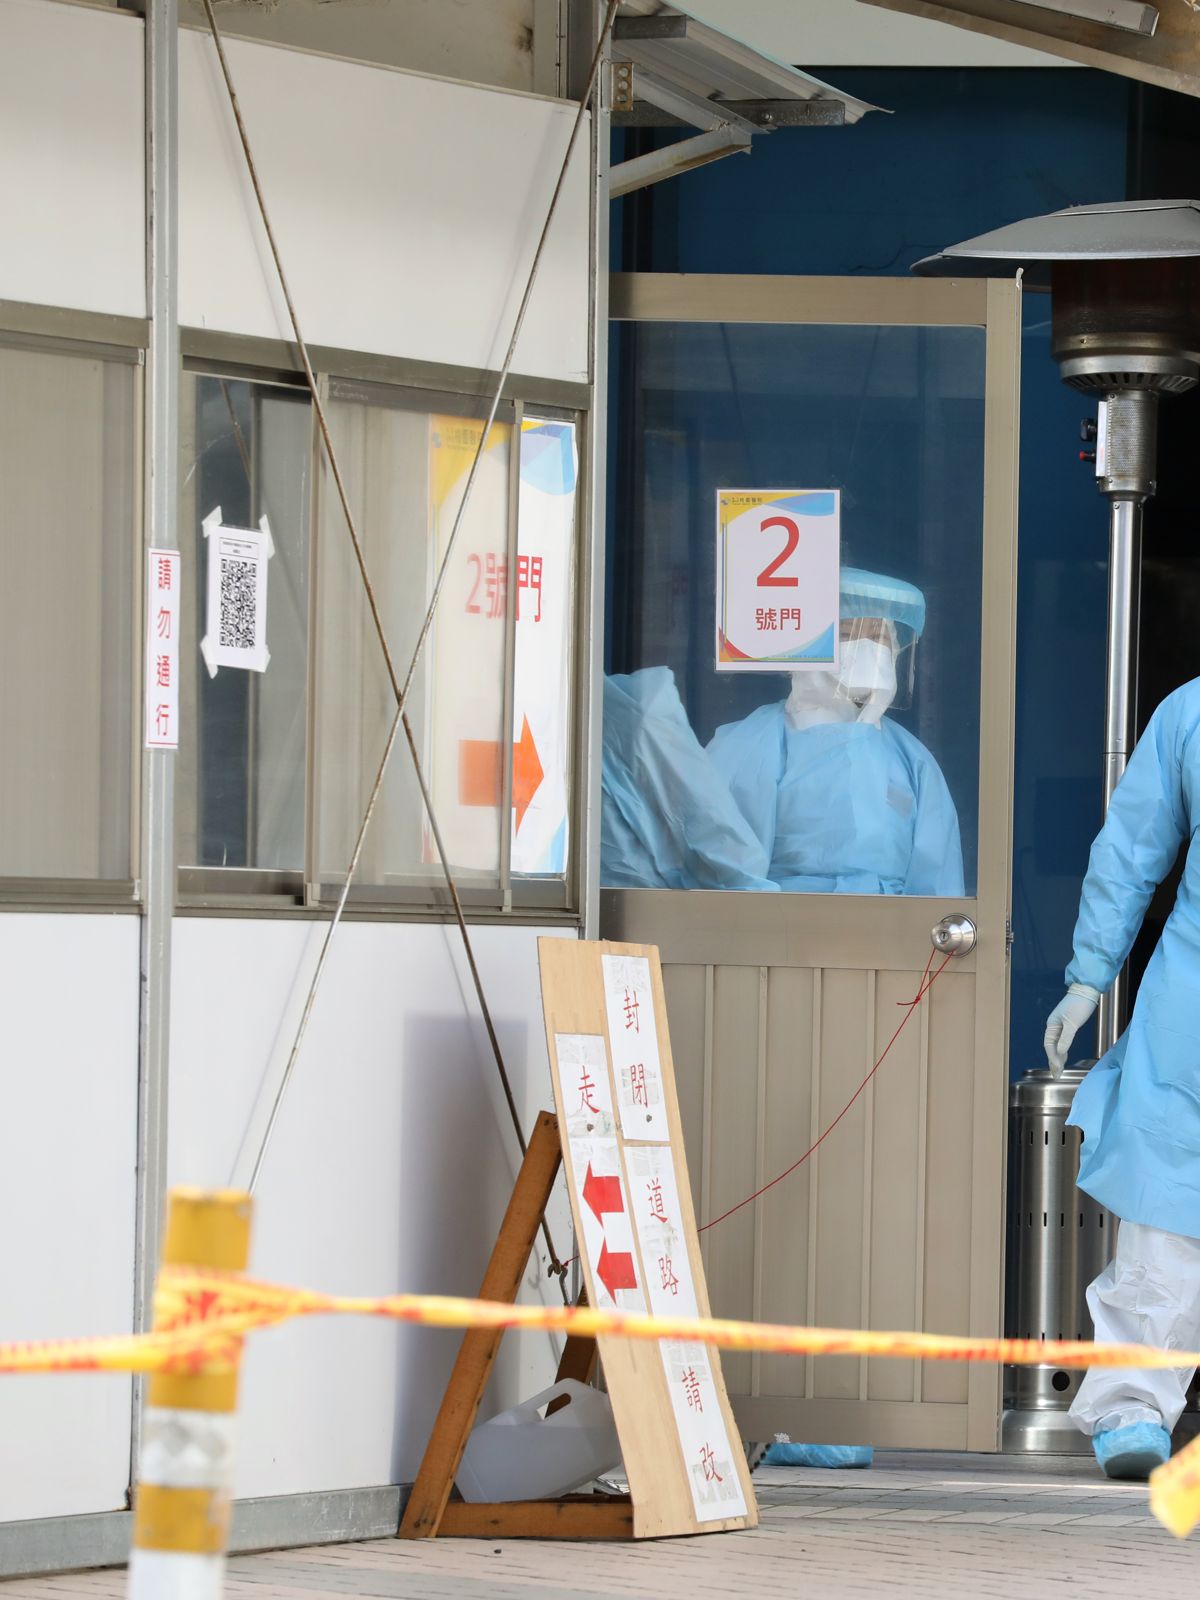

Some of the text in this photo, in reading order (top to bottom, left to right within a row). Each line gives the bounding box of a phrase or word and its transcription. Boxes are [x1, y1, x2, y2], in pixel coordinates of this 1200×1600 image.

[756, 516, 800, 587] 2
[465, 552, 544, 624] 2號門
[755, 608, 801, 631] 號門
[156, 557, 172, 737] 請勿通行
